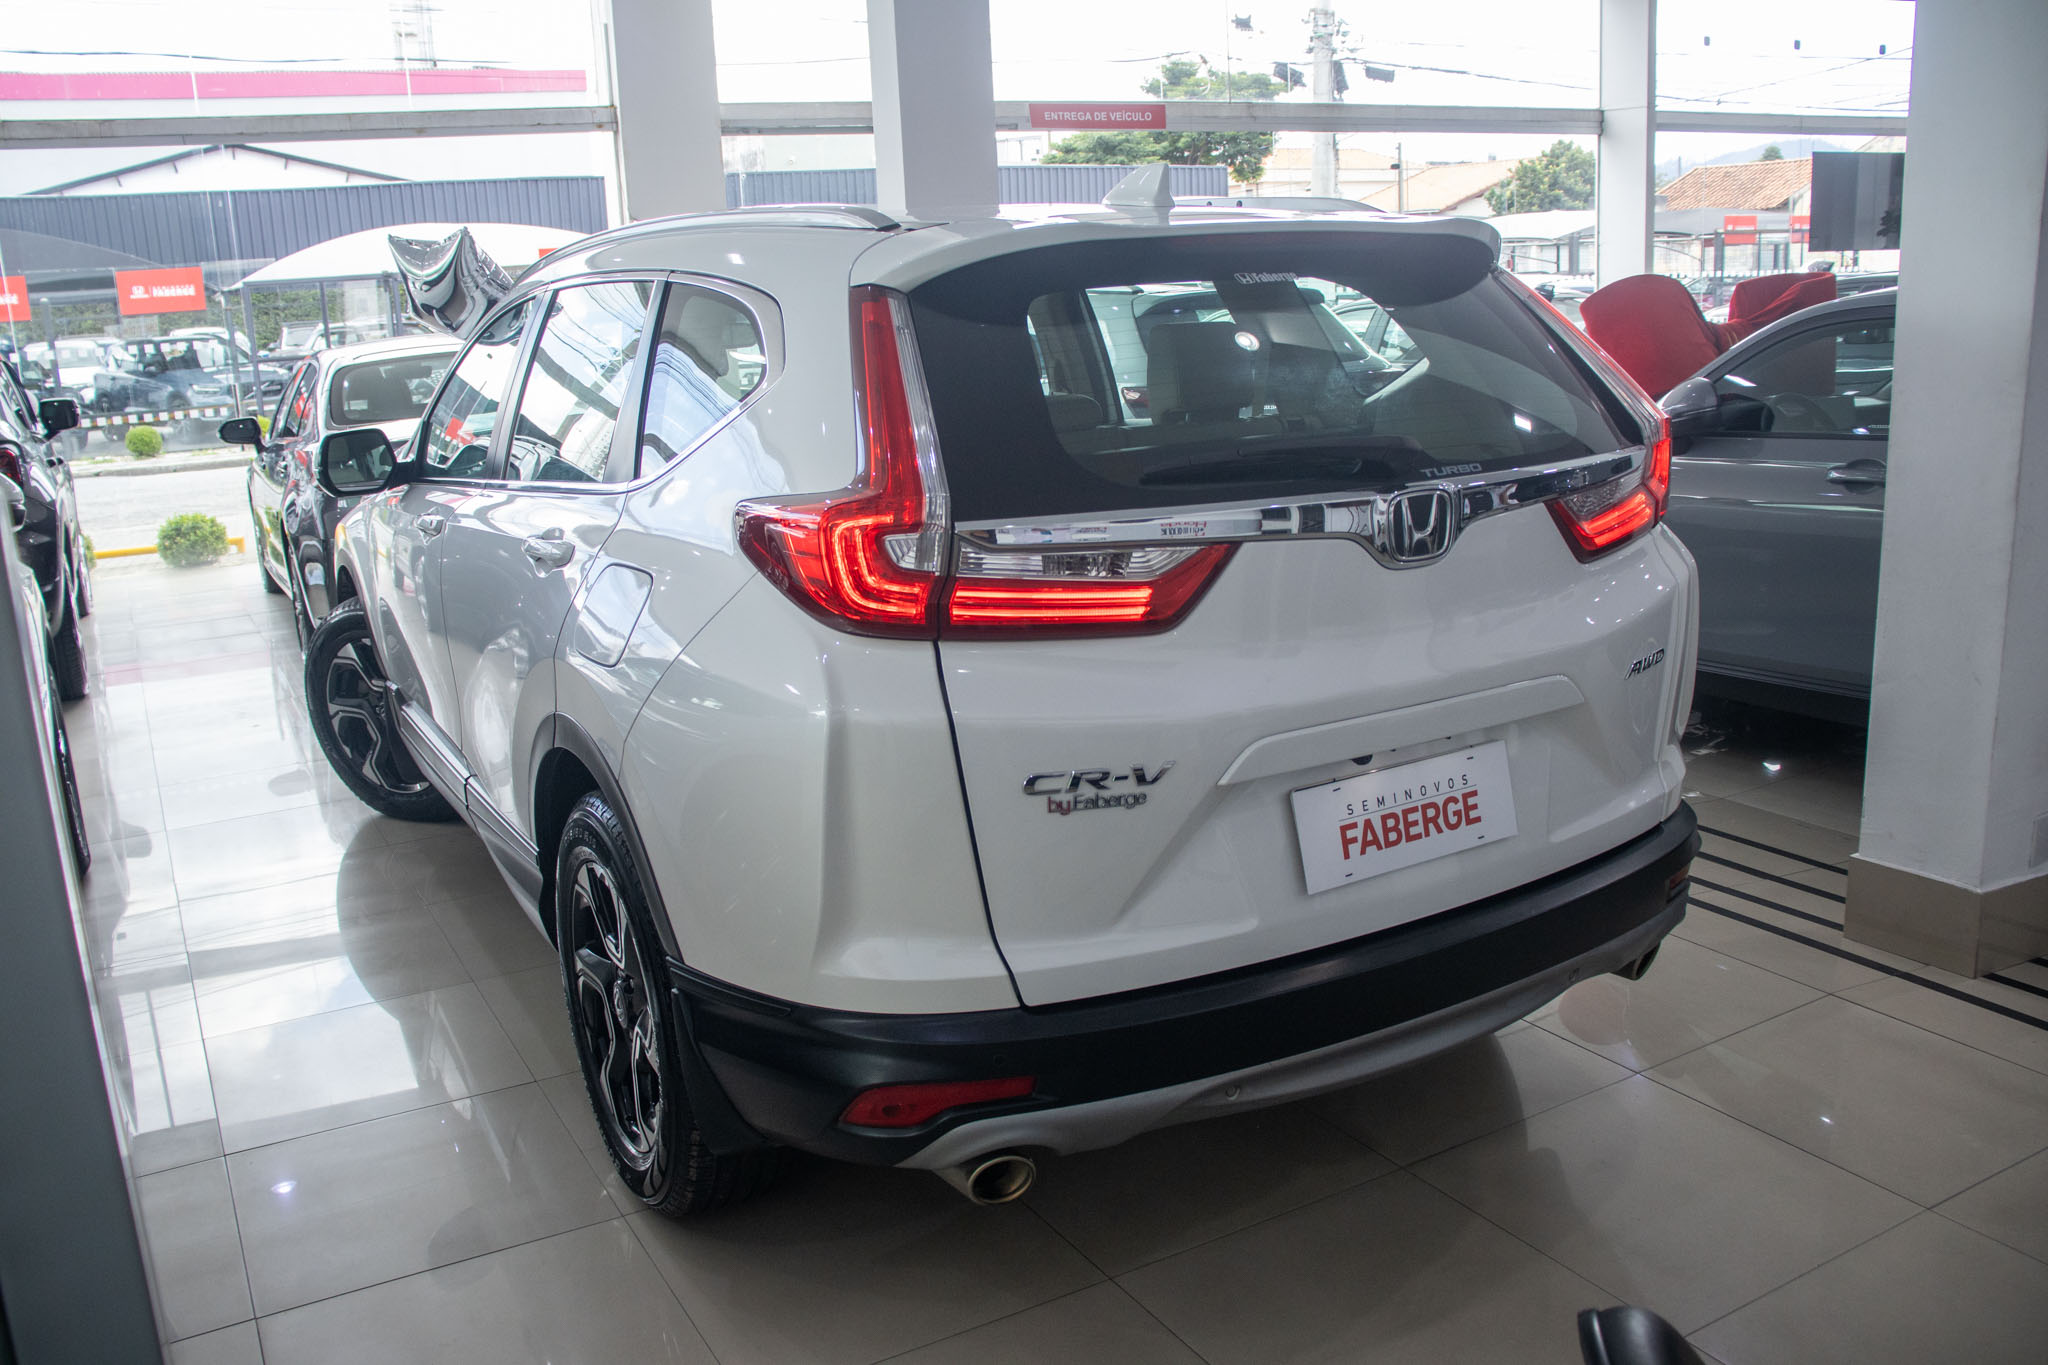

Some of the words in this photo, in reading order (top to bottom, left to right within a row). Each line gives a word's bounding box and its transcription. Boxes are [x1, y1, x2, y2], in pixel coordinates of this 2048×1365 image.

[1044, 111, 1092, 121] ENTREGA
[1094, 111, 1107, 121] DE
[1110, 109, 1153, 121] VEÍCULO
[1420, 463, 1483, 478] TURBO
[1624, 648, 1665, 681] AWD
[1022, 760, 1177, 796] CR-V
[1346, 774, 1470, 816] SEMINOVOS
[1339, 789, 1482, 861] FABERGE
